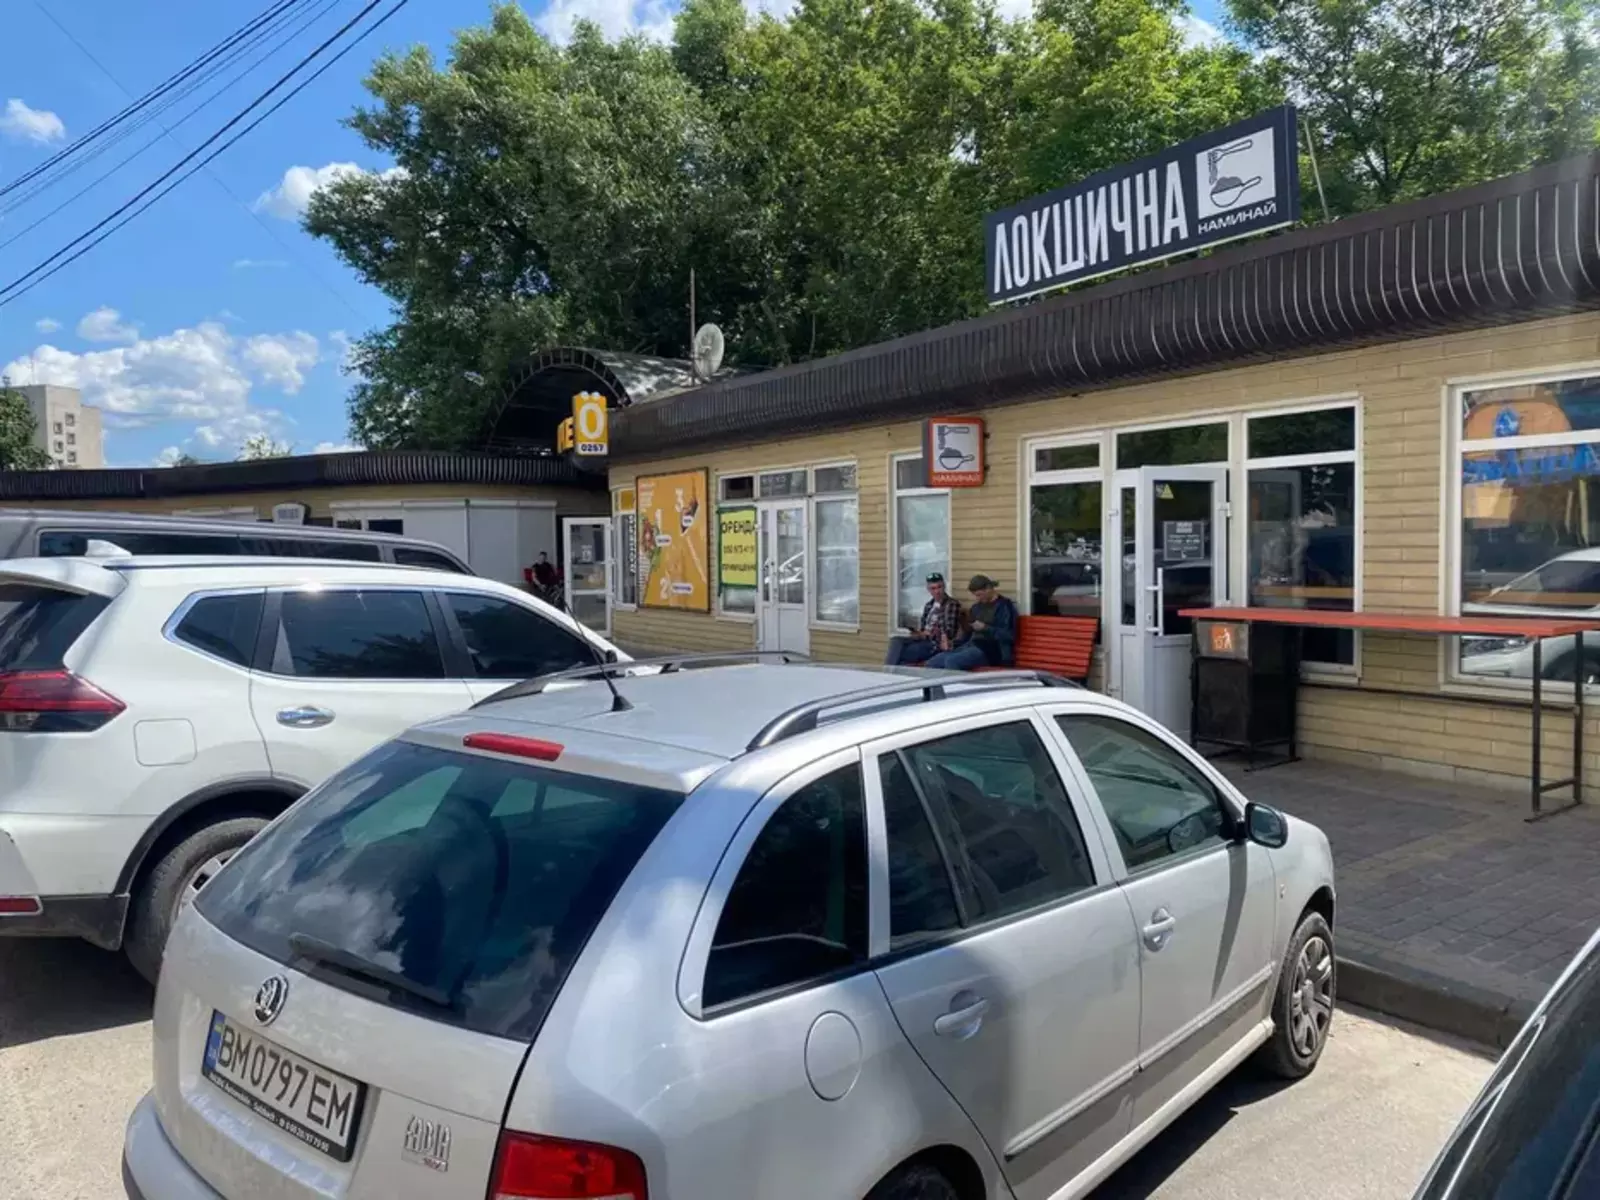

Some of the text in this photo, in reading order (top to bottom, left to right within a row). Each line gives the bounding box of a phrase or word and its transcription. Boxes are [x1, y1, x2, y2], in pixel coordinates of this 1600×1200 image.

[994, 161, 1188, 294] ЛОКШИЧНА
[1197, 201, 1277, 235] НАМИНАЙ
[581, 443, 605, 452] 0257
